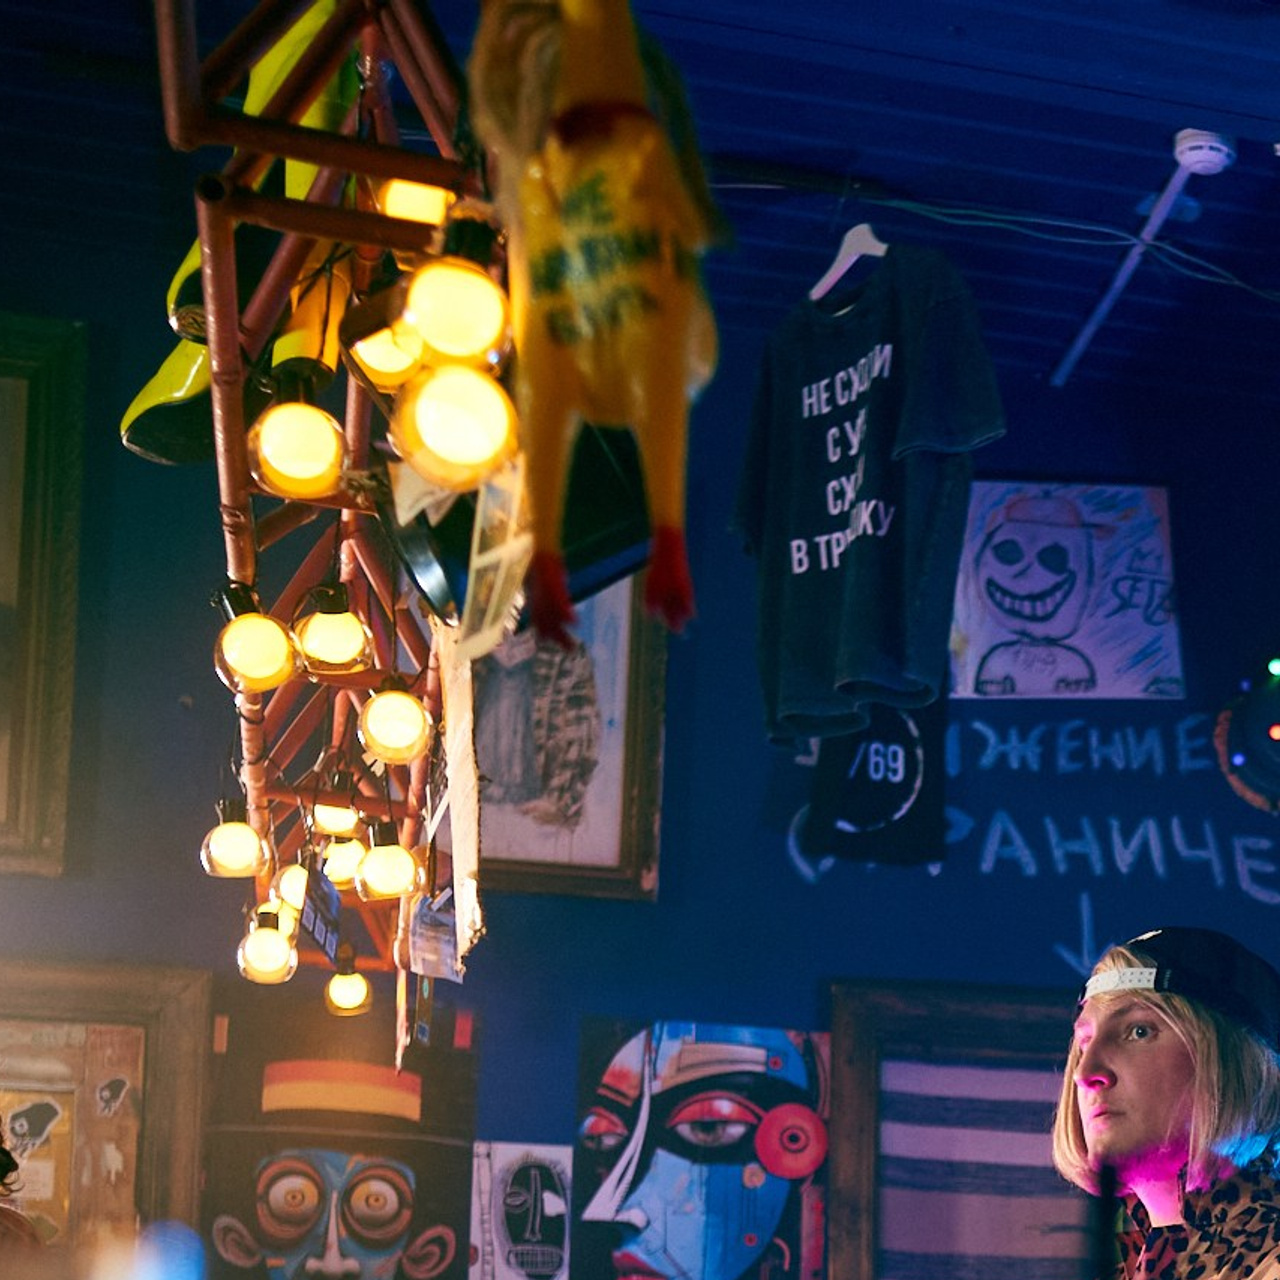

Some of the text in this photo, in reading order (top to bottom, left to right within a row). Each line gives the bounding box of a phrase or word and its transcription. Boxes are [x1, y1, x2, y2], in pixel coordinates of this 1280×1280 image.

[801, 376, 833, 419] НЕ
[825, 404, 868, 464] С У
[789, 537, 810, 576] В
